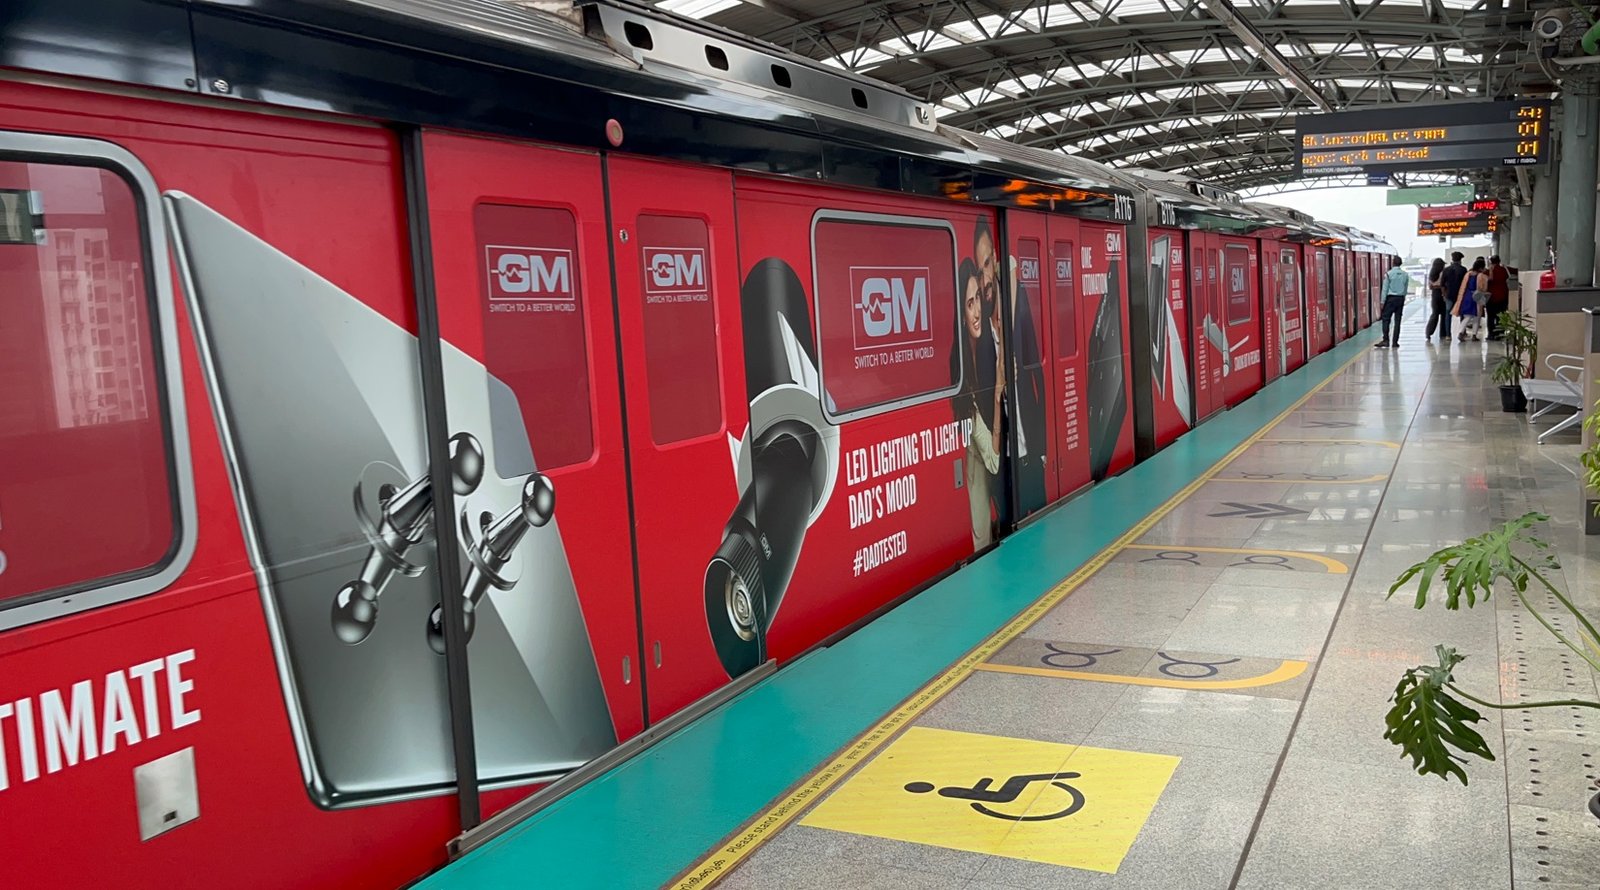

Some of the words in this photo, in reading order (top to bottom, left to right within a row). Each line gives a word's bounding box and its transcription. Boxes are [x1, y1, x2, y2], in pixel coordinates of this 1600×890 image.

[1518, 121, 1539, 136] 01
[1517, 141, 1537, 156] 01
[1114, 193, 1132, 221] A116
[1161, 202, 1176, 226] B116
[1105, 233, 1121, 252] GM
[497, 253, 570, 293] GM
[652, 253, 704, 287] GM
[1020, 260, 1039, 280] GM
[1056, 260, 1072, 279] GM
[489, 303, 516, 312] SWITCH
[516, 303, 526, 312] TO
[526, 303, 532, 312] A
[532, 303, 554, 312] BETTER
[554, 303, 576, 312] WORLD
[861, 277, 929, 337] GM
[854, 353, 879, 369] SWITCH
[879, 352, 889, 365] TO
[889, 351, 894, 364] A
[894, 349, 914, 363] BETTER
[914, 346, 934, 359] WORLD
[846, 448, 868, 487] LED
[870, 433, 919, 478] LIGHTING
[920, 429, 933, 461] TO
[934, 421, 960, 457] LIGHT
[961, 418, 973, 448] UP
[848, 484, 883, 529] DAD'S
[885, 473, 917, 515] MOOD
[853, 530, 907, 578] #DADTESTED
[726, 833, 757, 853] Please
[754, 813, 778, 834] stand
[775, 797, 802, 817] behind
[797, 788, 814, 800] the
[811, 773, 833, 790] yellow
